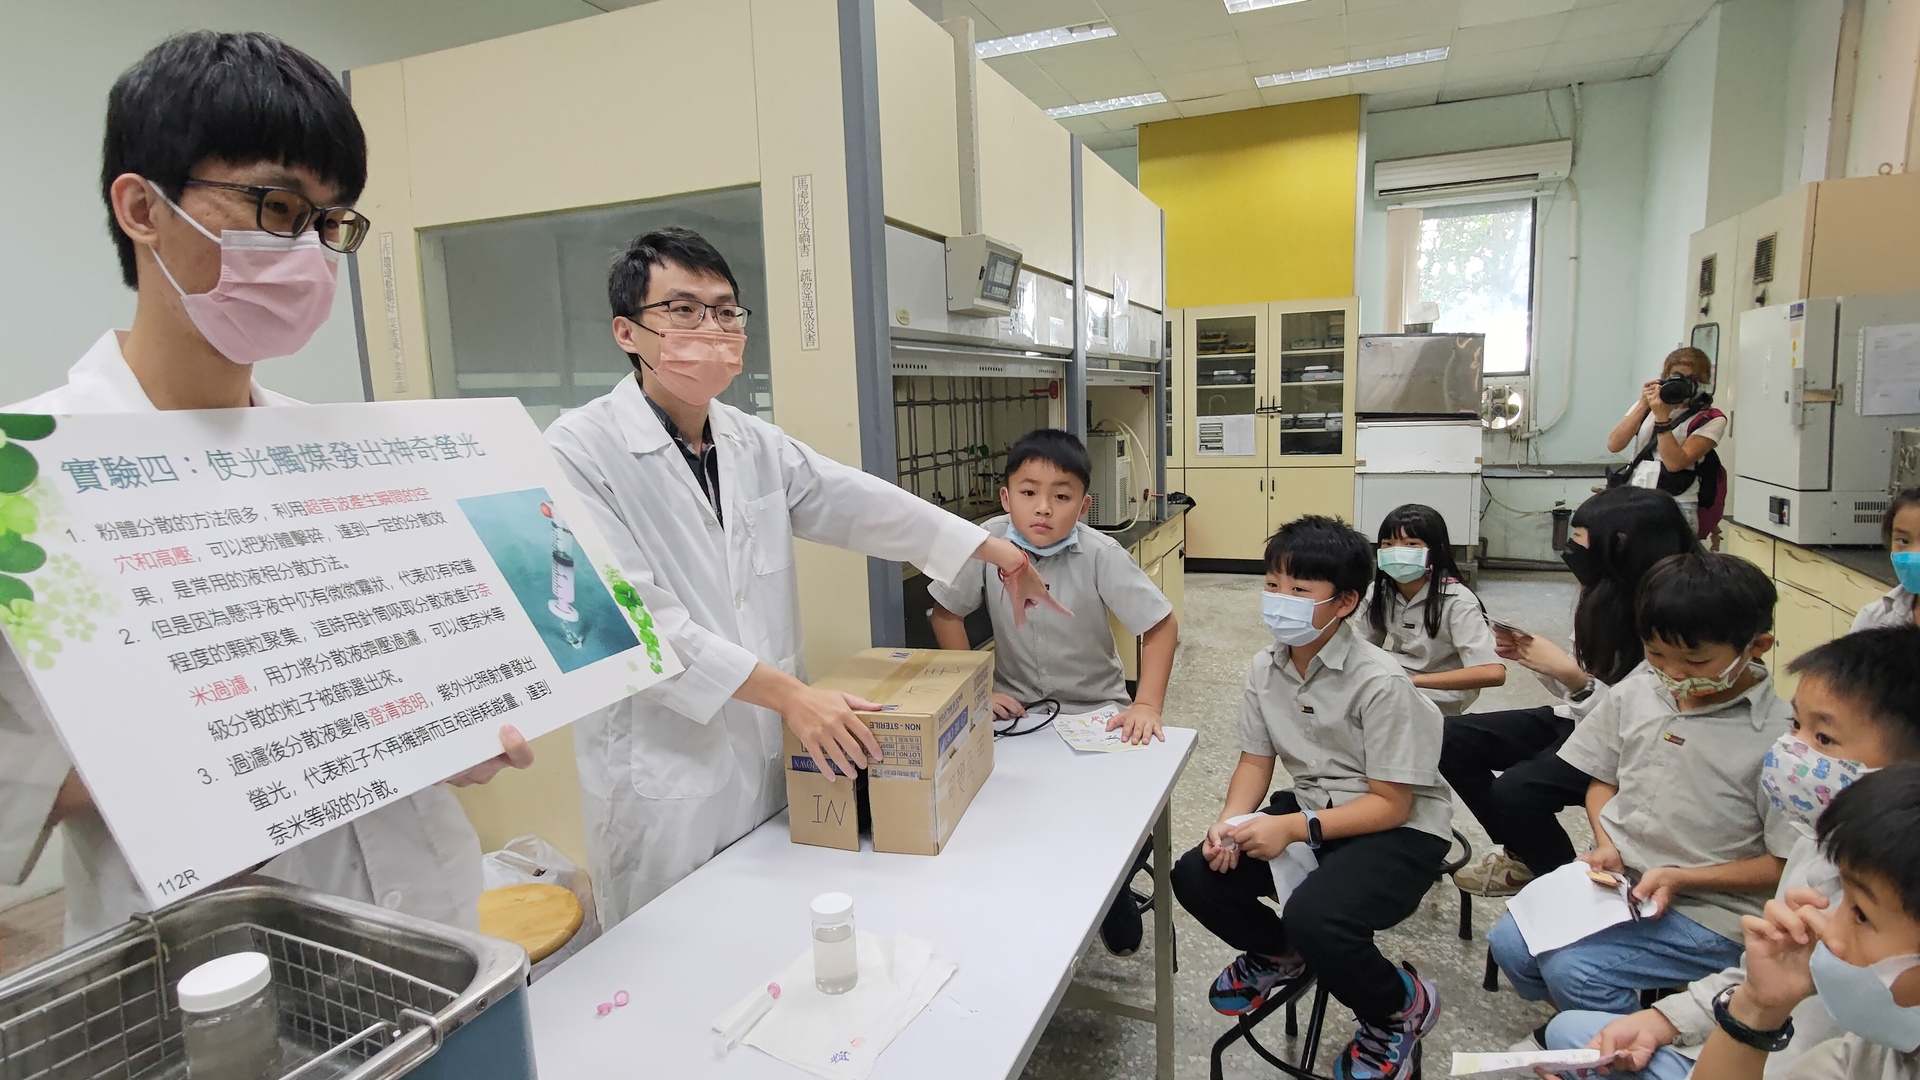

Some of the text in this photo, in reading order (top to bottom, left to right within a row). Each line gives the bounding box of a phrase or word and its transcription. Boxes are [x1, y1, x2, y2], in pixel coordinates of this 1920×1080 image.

[61, 432, 486, 494] 實驗四：使光觸媒發出神奇螢光
[119, 628, 141, 646] 2.
[870, 721, 899, 729] STERILE
[905, 723, 921, 731] NON
[197, 767, 219, 785] 3.
[157, 868, 200, 896] 112R
